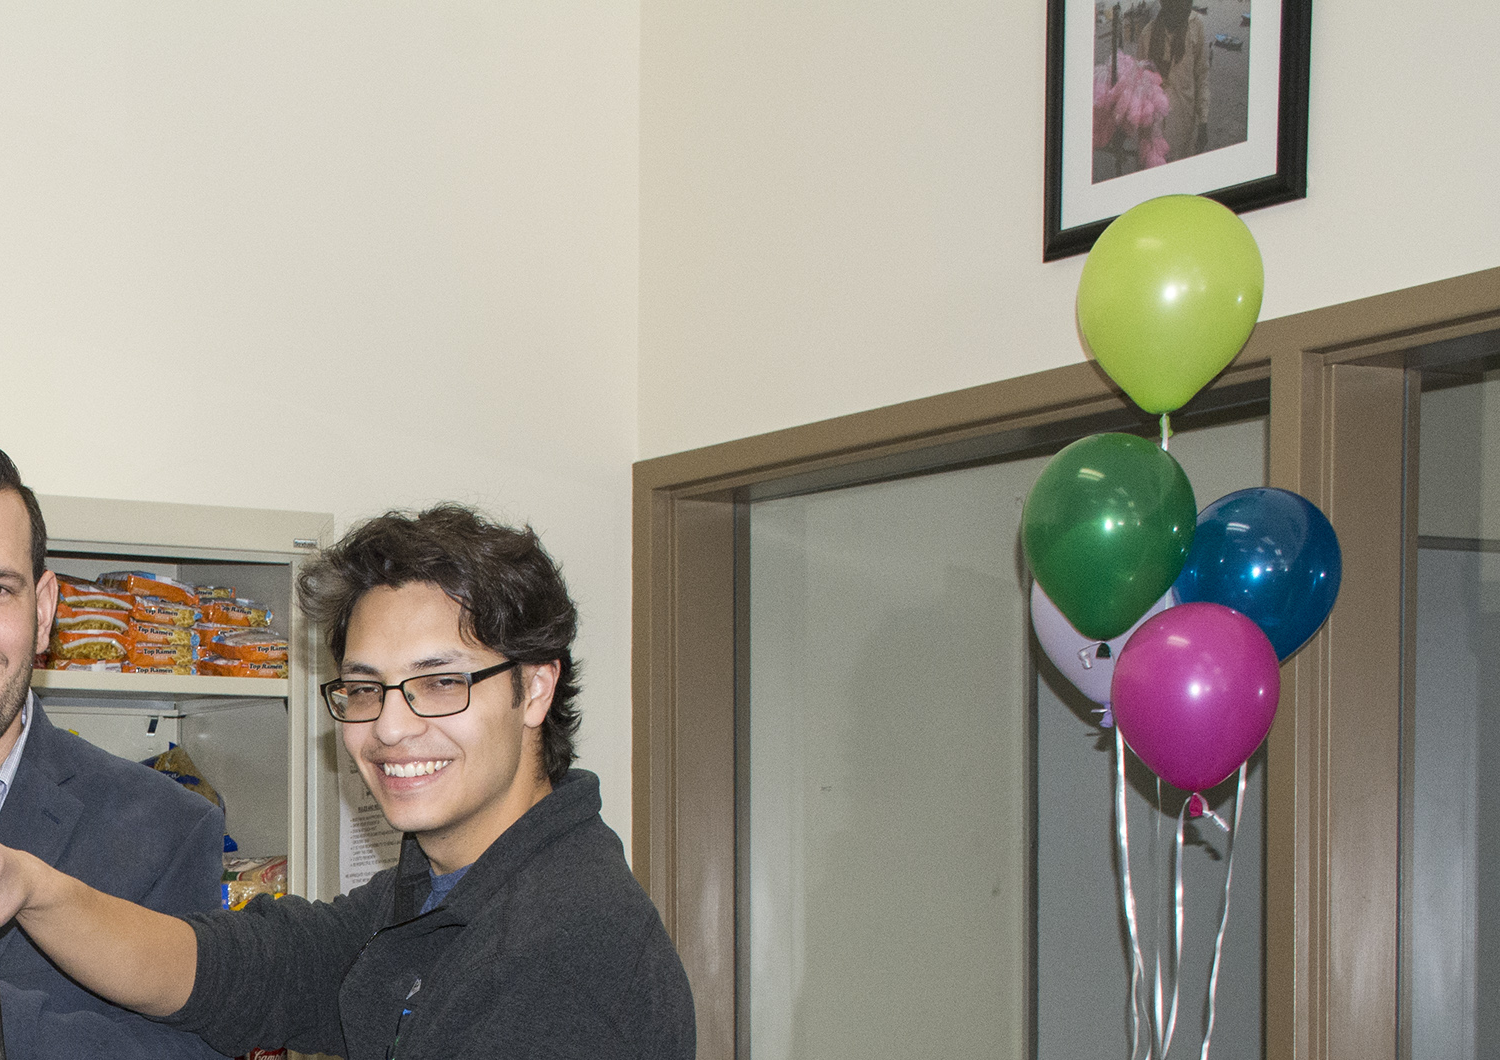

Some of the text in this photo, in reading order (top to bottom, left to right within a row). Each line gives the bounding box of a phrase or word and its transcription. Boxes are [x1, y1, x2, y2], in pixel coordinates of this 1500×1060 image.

[157, 608, 178, 616] Ramen
[138, 626, 173, 636] Top Ramen
